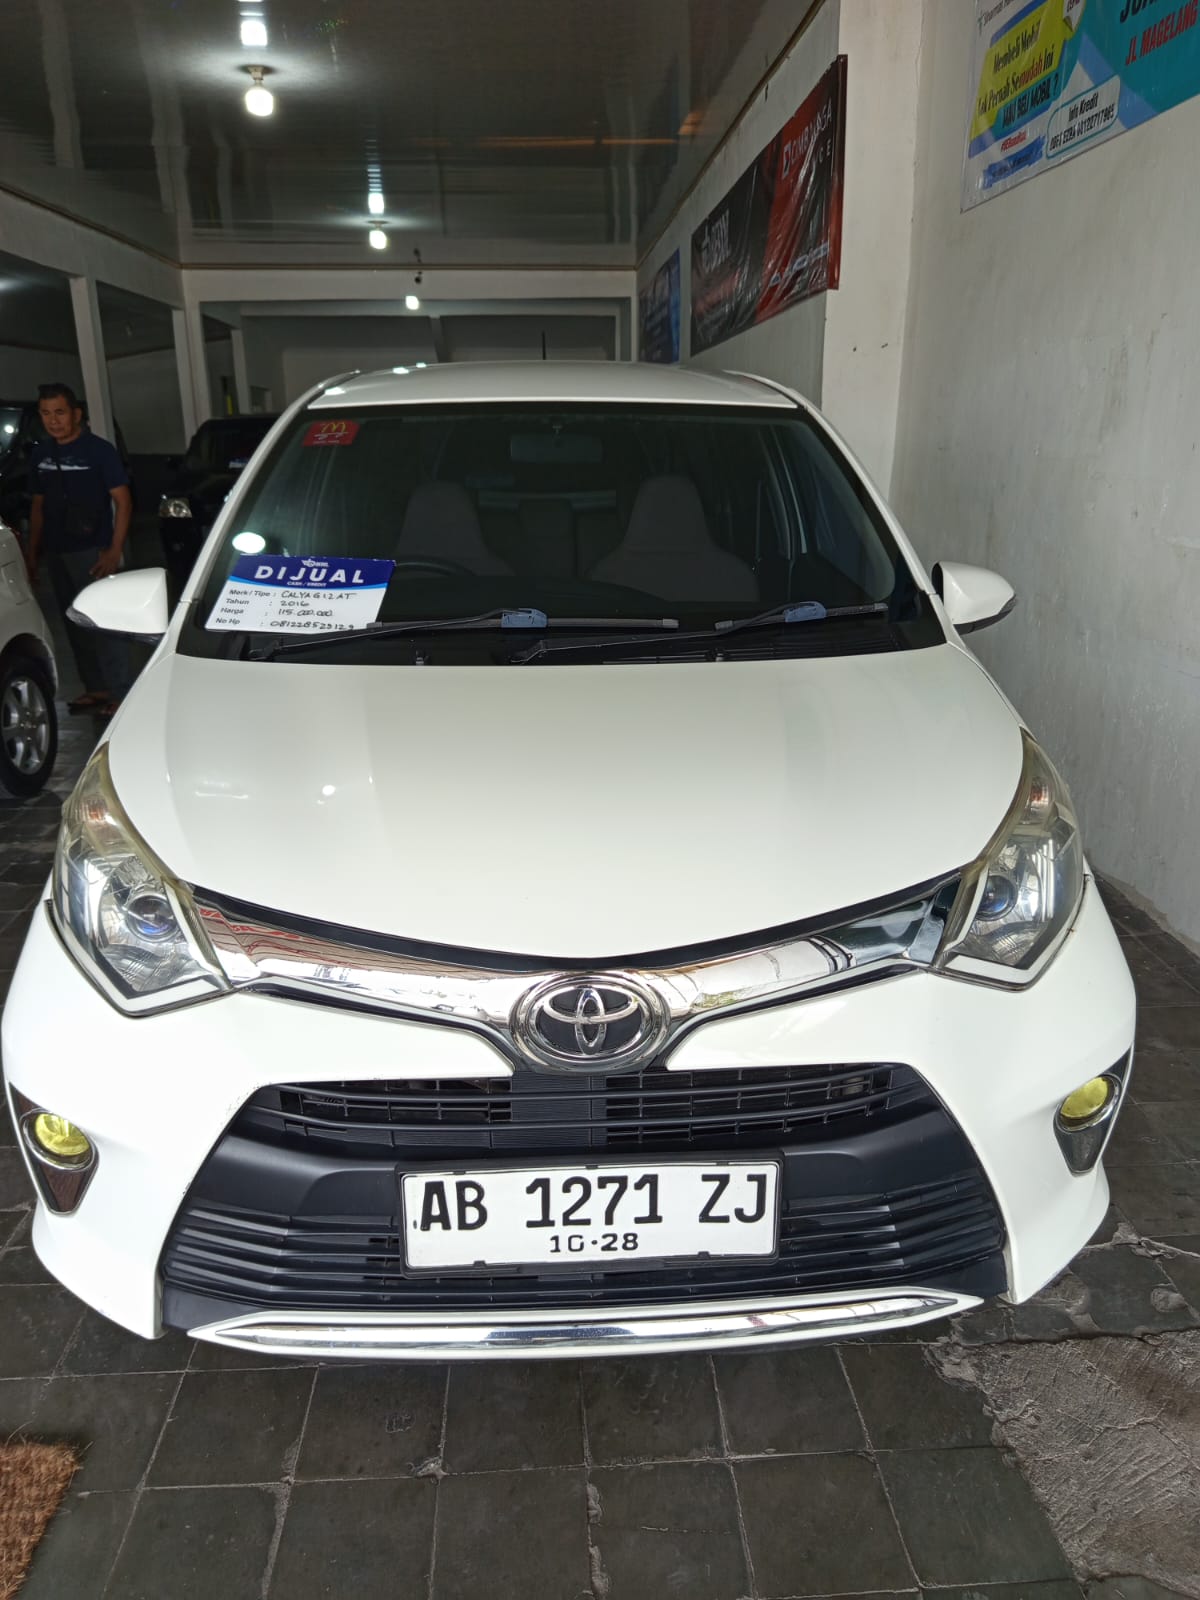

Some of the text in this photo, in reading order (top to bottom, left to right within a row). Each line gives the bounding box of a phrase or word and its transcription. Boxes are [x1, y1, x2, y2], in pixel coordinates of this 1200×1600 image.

[254, 565, 365, 584] DIJUAL
[220, 607, 245, 615] Harga
[420, 1173, 767, 1231] AB 1271 ZJ
